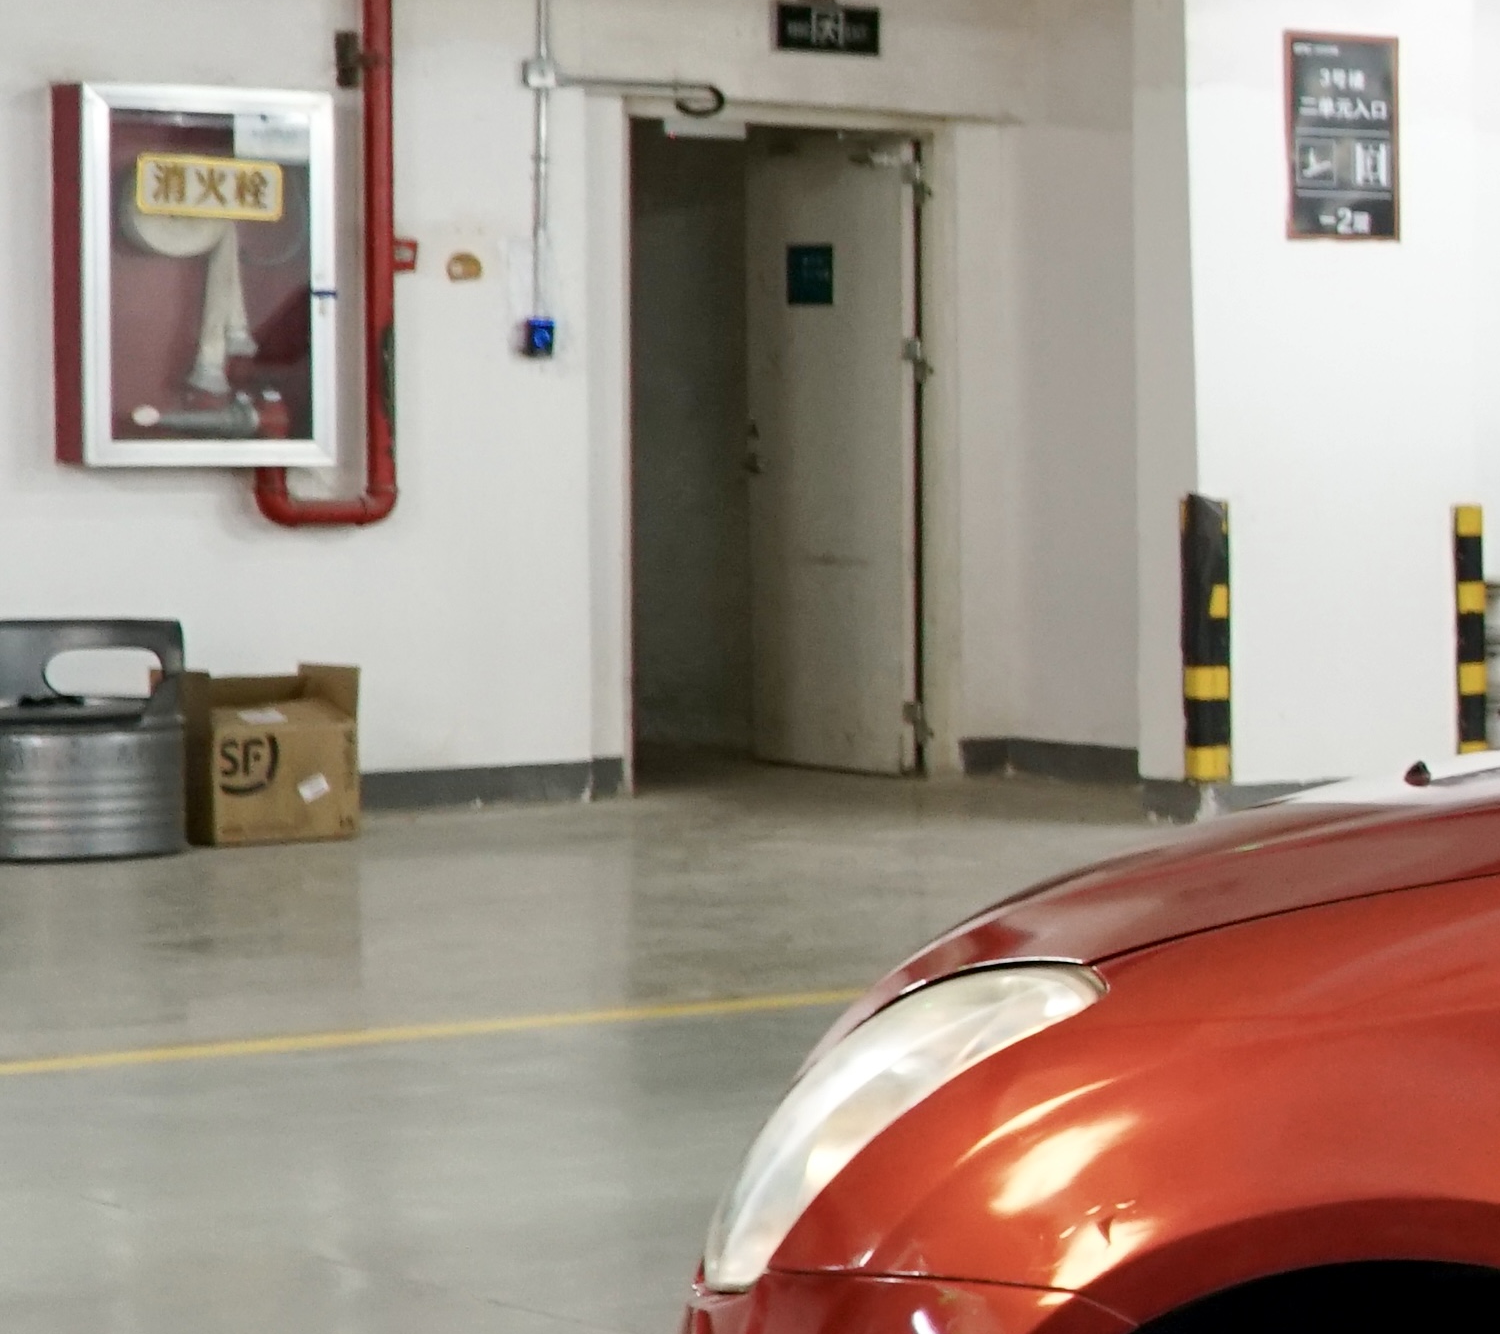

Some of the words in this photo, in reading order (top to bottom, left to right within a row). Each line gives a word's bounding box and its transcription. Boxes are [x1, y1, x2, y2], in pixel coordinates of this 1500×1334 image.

[152, 161, 268, 209] 消火栓
[219, 737, 264, 777] SF
